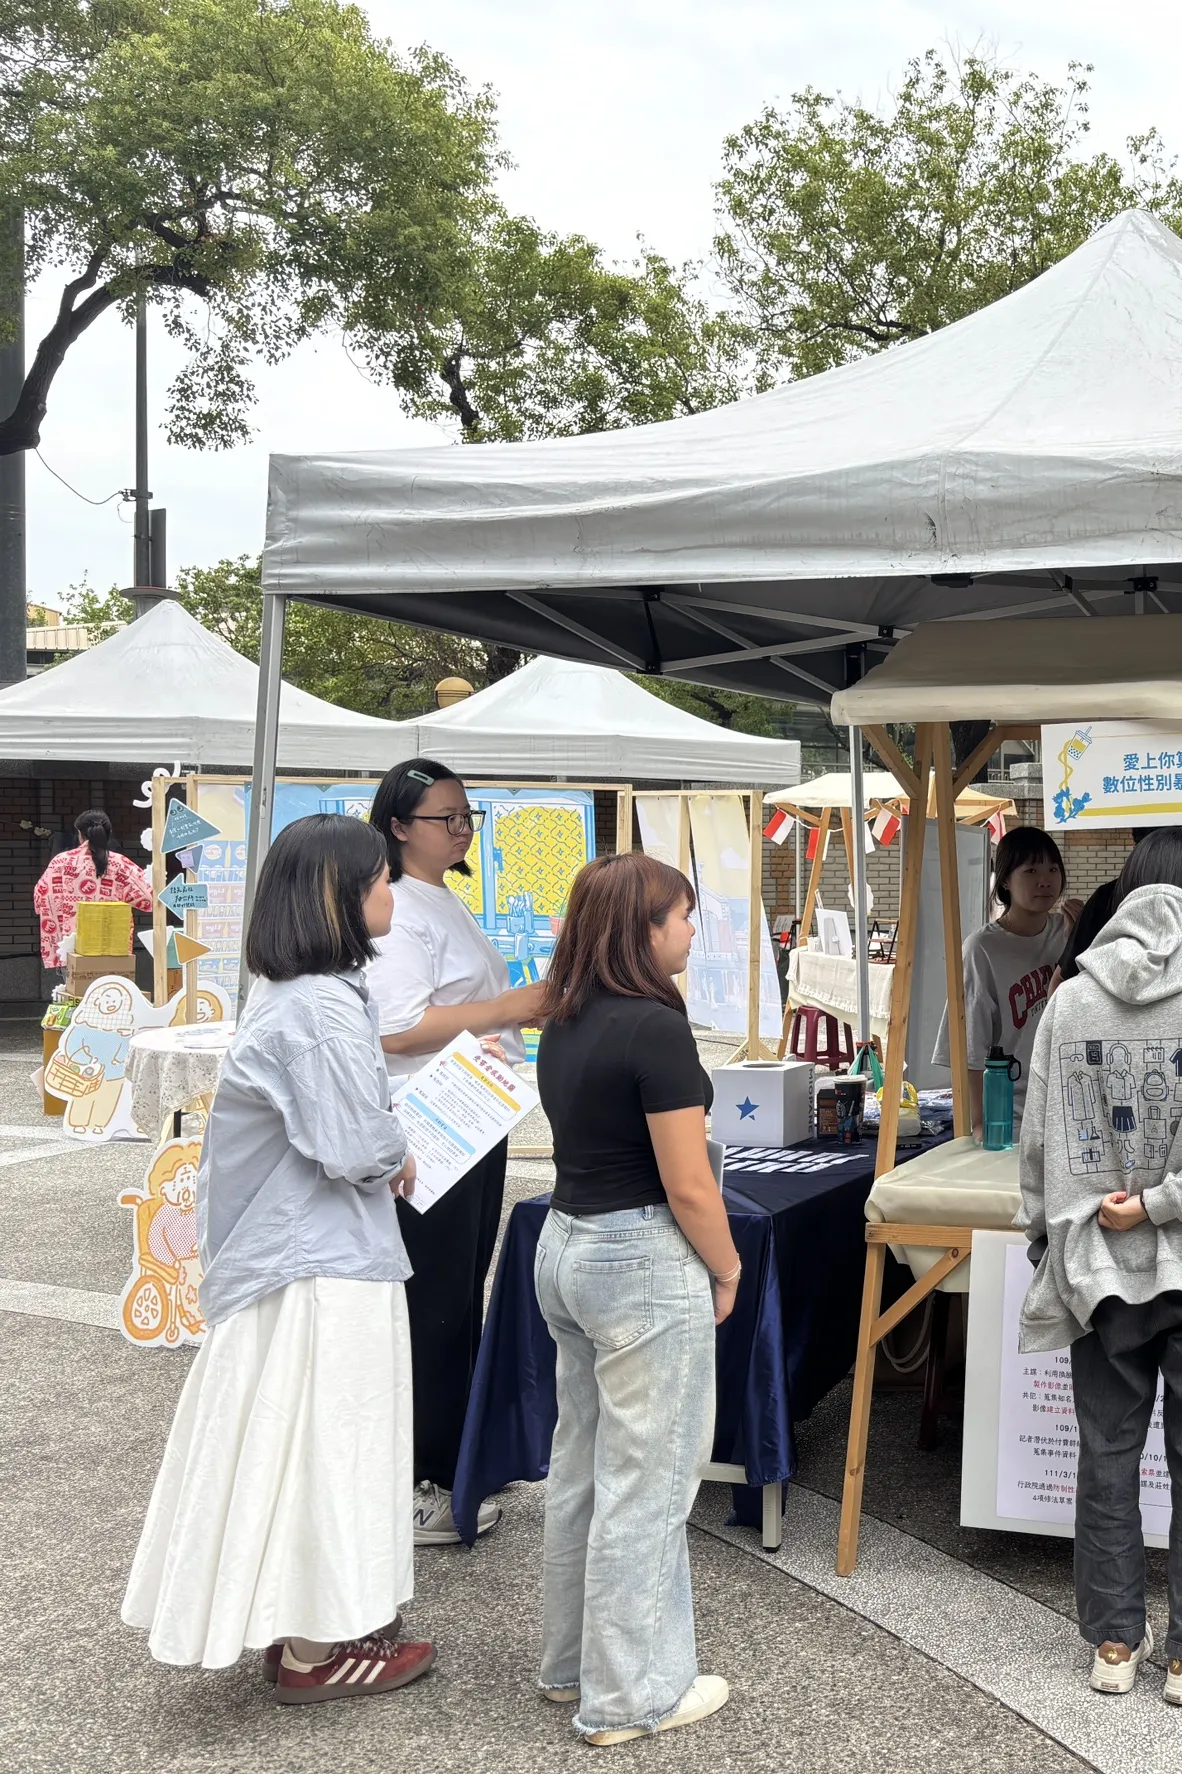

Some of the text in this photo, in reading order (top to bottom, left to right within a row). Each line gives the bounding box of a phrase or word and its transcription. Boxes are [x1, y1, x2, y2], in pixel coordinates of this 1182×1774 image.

[1008, 964, 1056, 1029] CHAP
[1022, 1392, 1074, 1403] 共犯：蒐集知名
[1017, 1480, 1077, 1494] 行政院通過防制性
